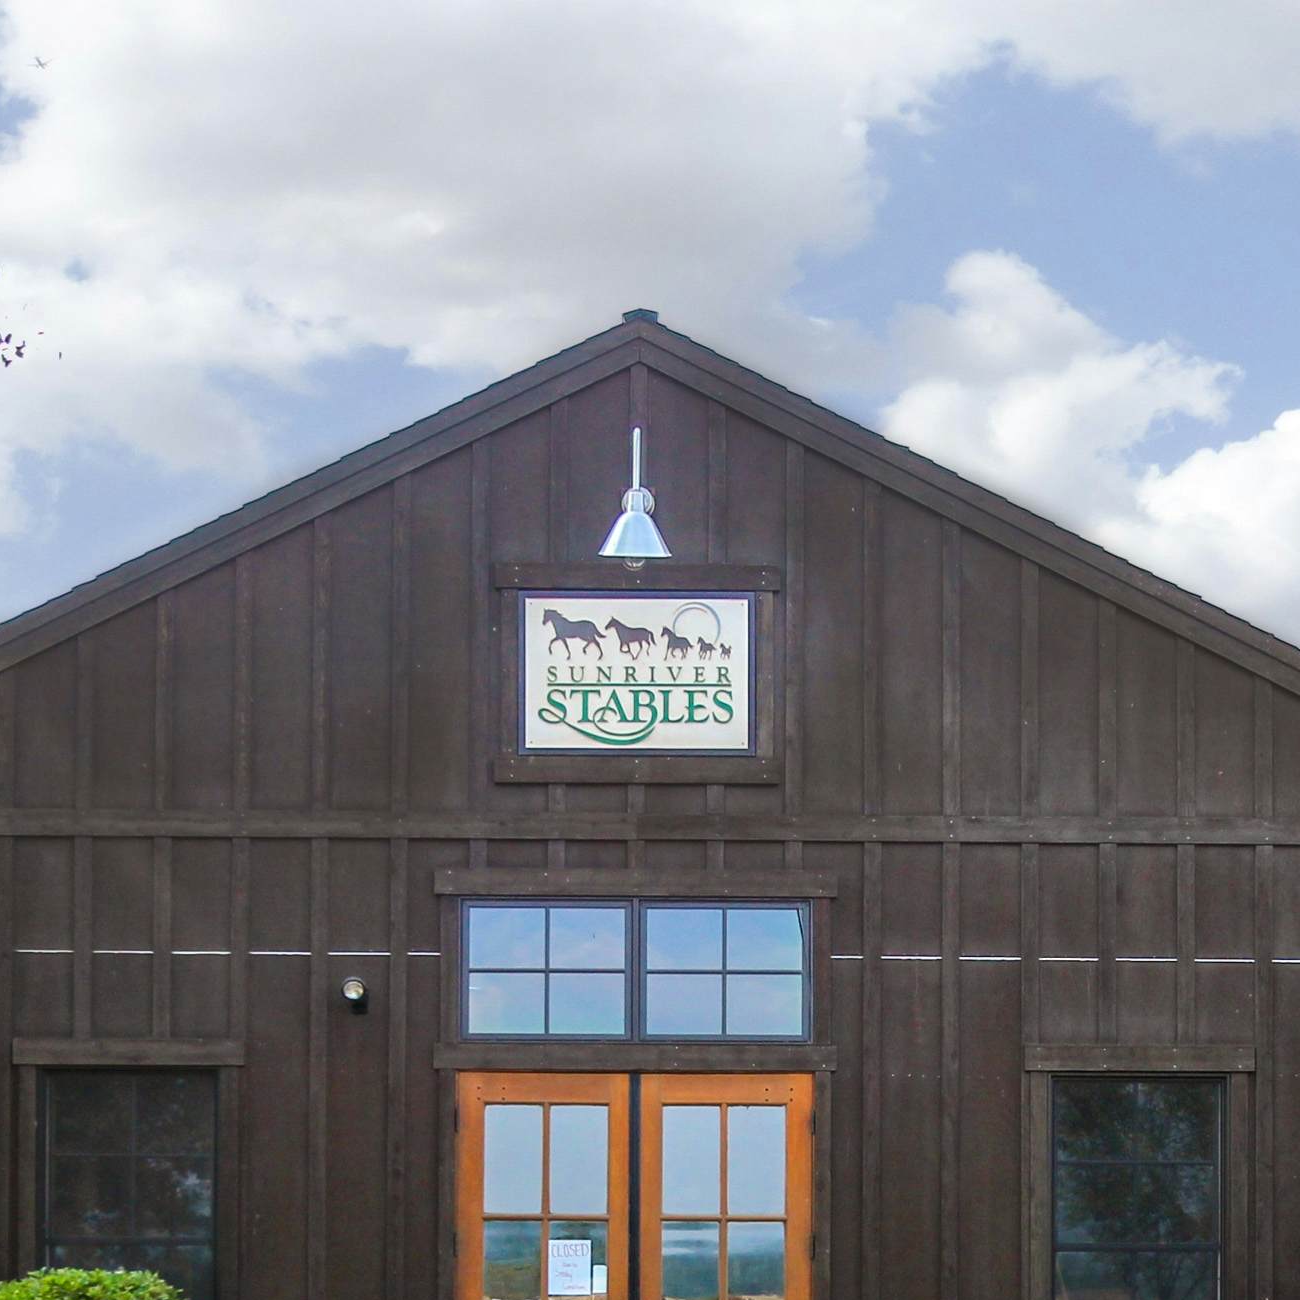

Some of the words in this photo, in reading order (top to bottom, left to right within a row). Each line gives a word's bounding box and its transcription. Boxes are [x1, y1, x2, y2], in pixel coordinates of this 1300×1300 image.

[547, 666, 731, 683] SUNRIVER
[538, 689, 734, 745] STABLES
[551, 1243, 589, 1257] CLOSED
